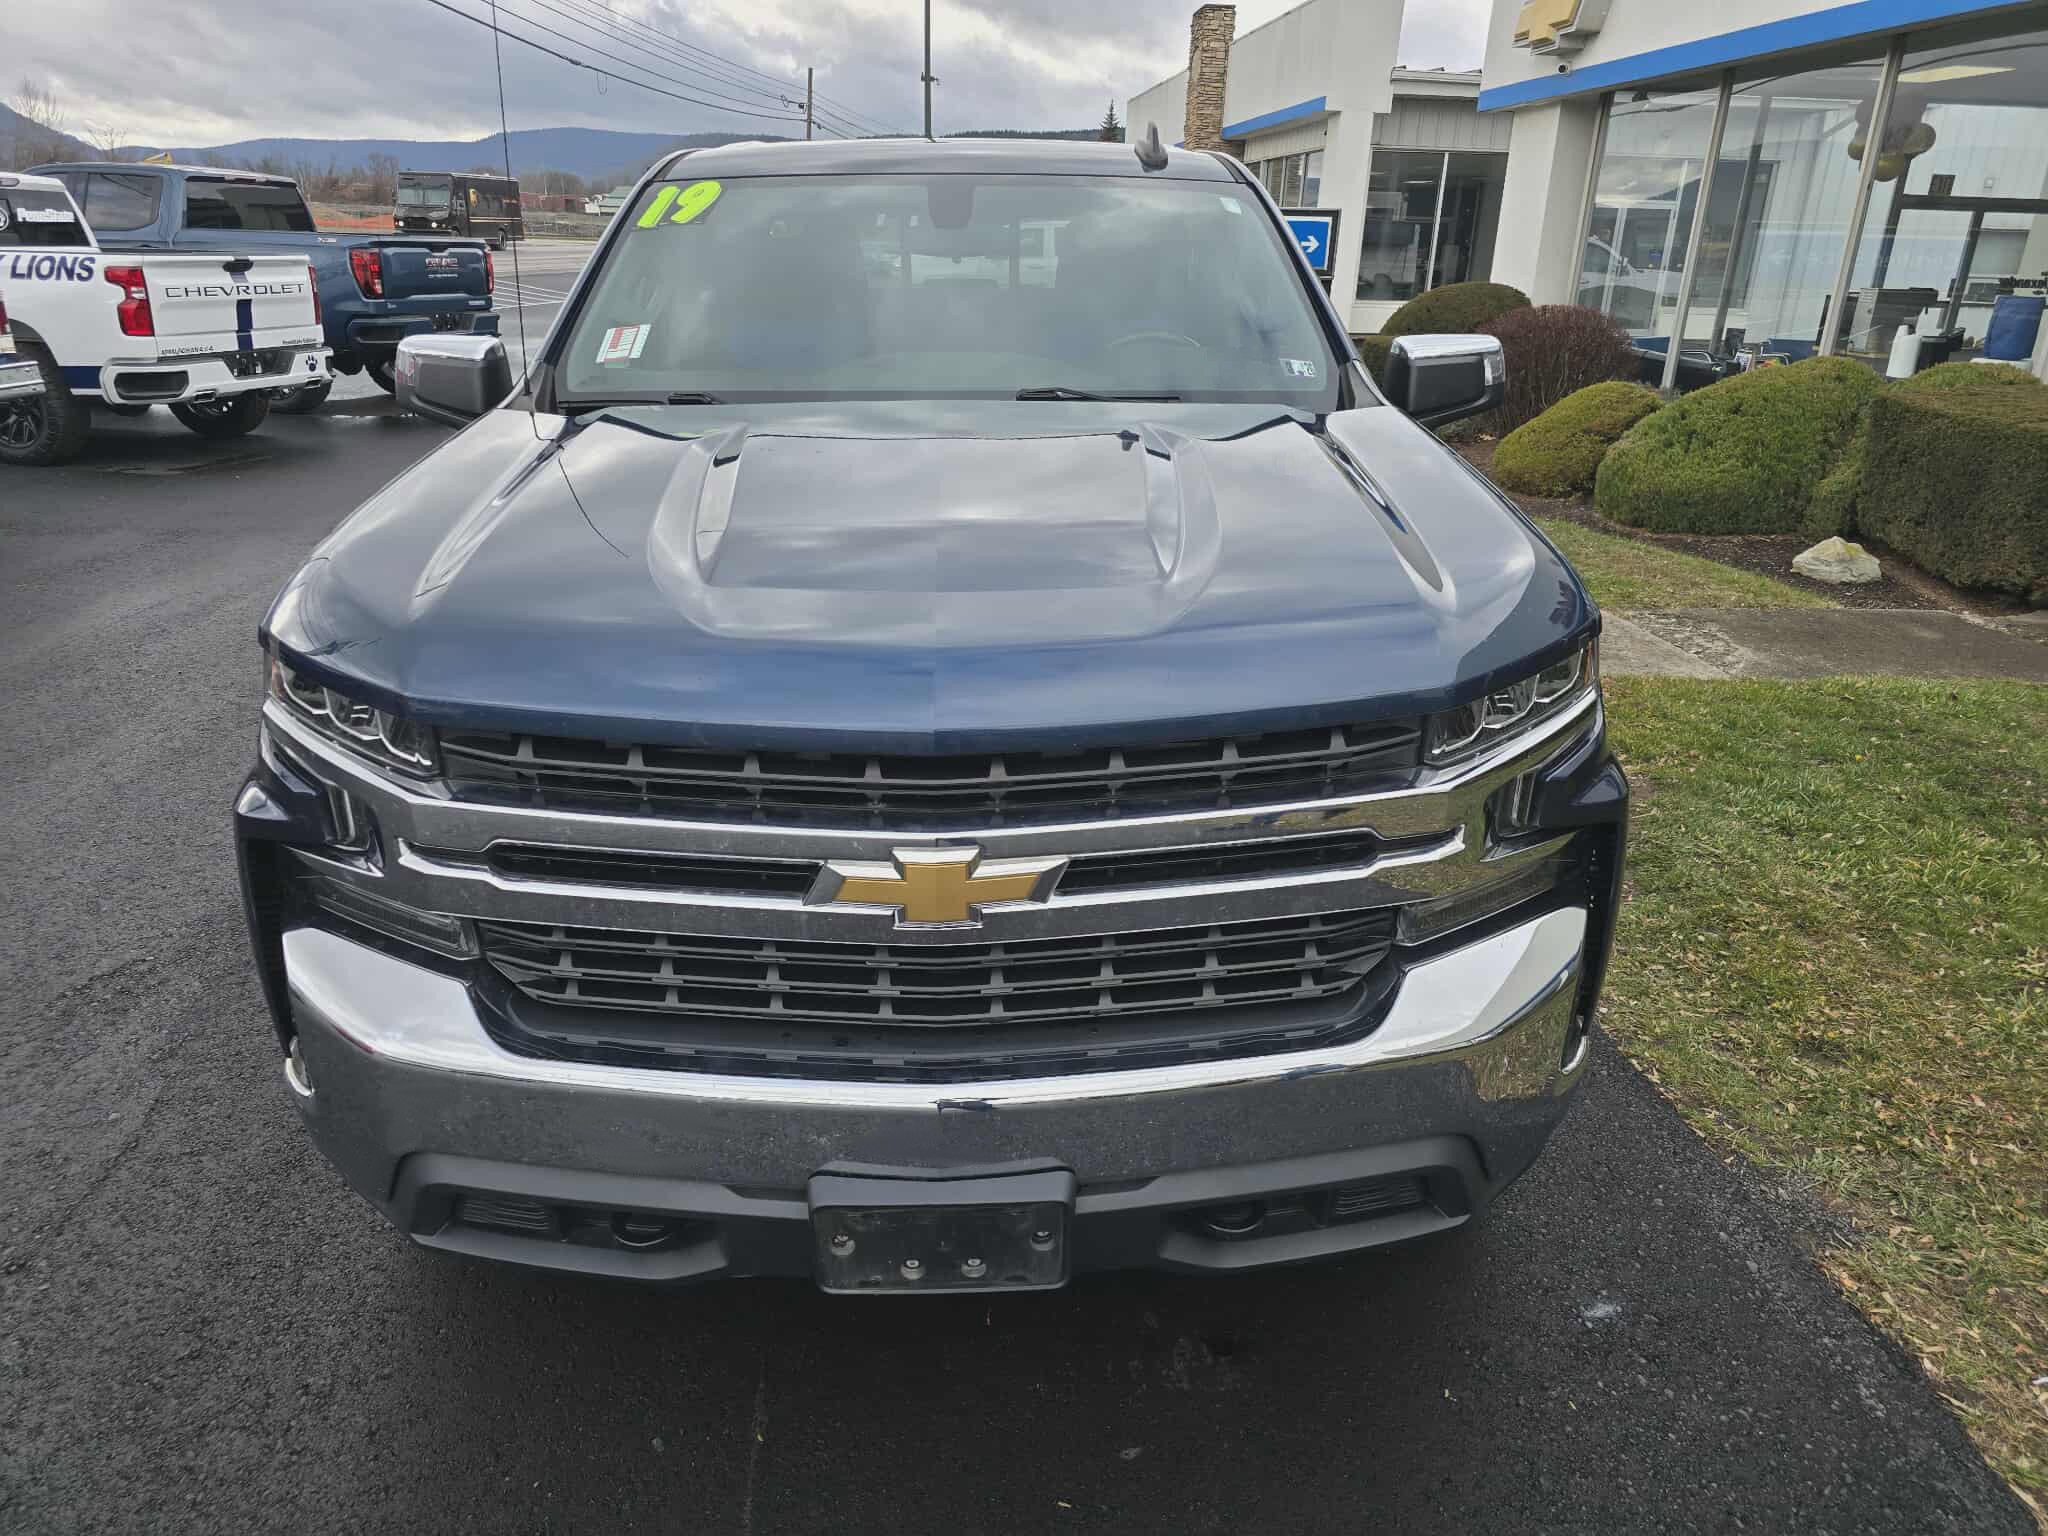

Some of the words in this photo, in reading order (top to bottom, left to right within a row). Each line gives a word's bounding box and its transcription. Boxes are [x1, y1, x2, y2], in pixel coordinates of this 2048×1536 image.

[637, 181, 721, 228] 19
[10, 254, 97, 282] LIONS
[165, 283, 305, 298] CHEVROLET
